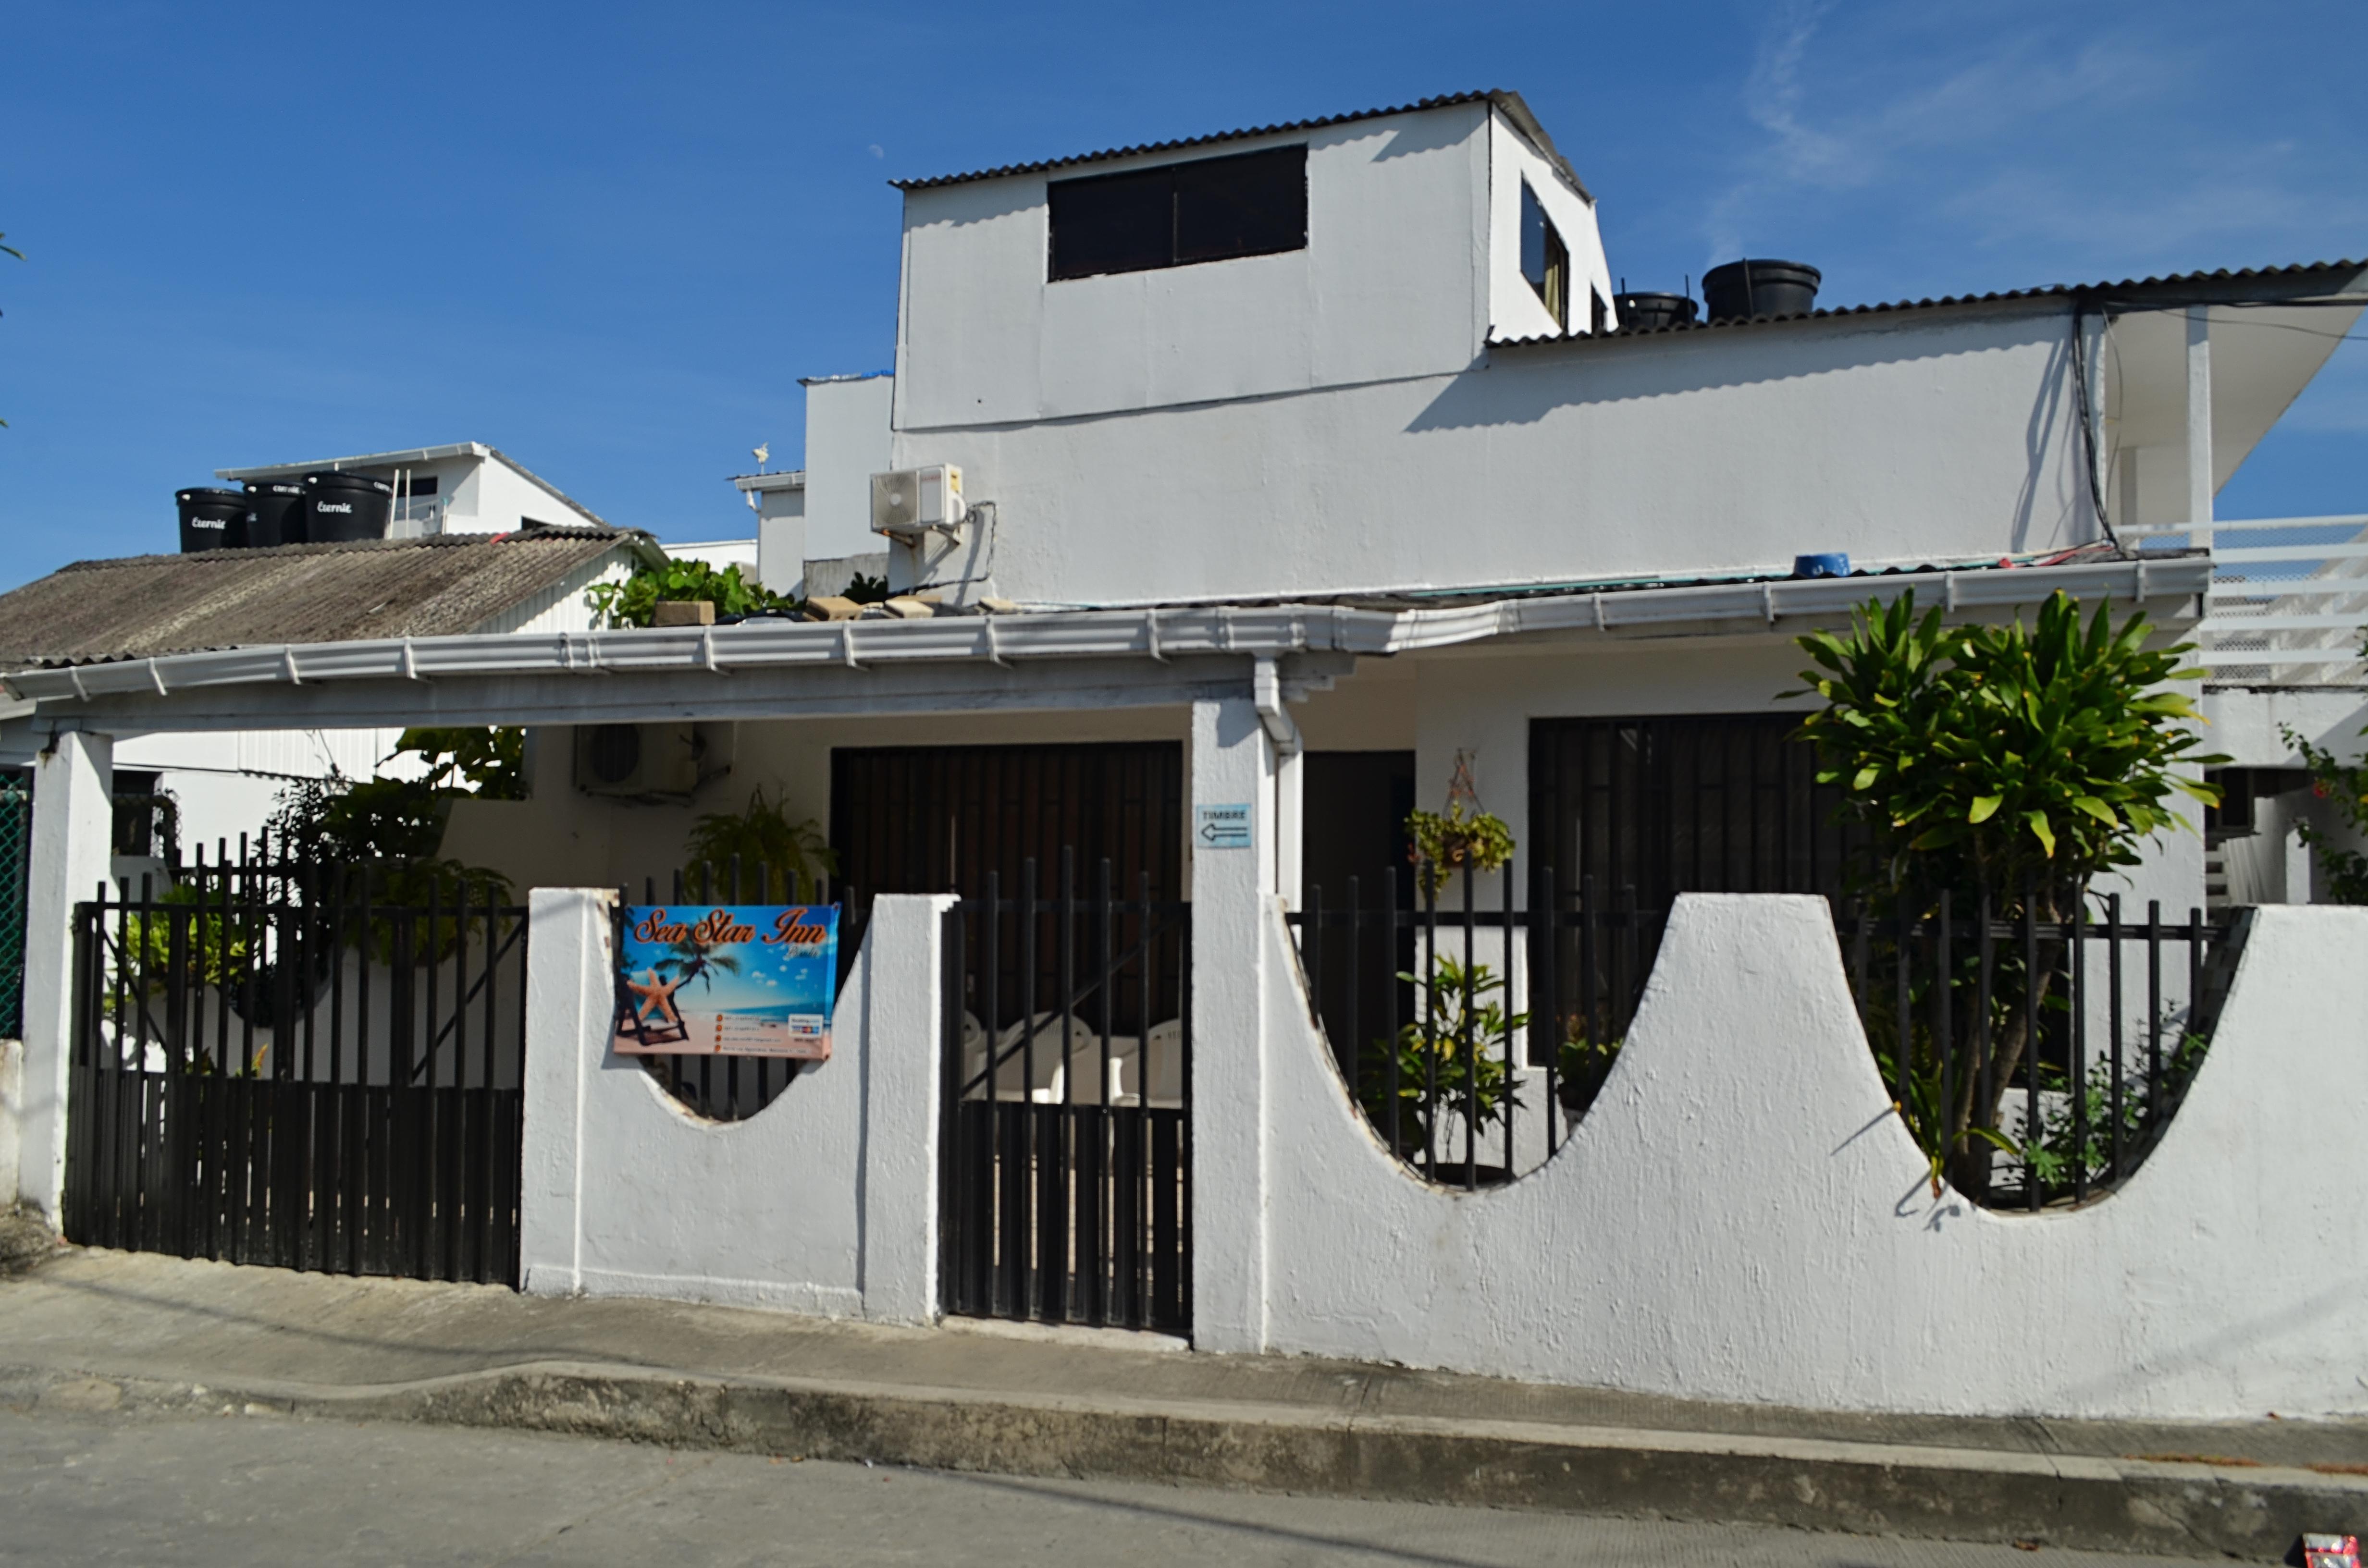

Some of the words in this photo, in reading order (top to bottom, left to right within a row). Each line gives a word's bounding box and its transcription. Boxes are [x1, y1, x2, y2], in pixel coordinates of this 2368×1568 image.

[317, 501, 352, 514] Eternit
[192, 516, 226, 529] Eternit
[1203, 810, 1246, 821] TIMBRE
[634, 907, 688, 944] Sea
[692, 907, 756, 945] Star
[762, 907, 827, 945] Inn
